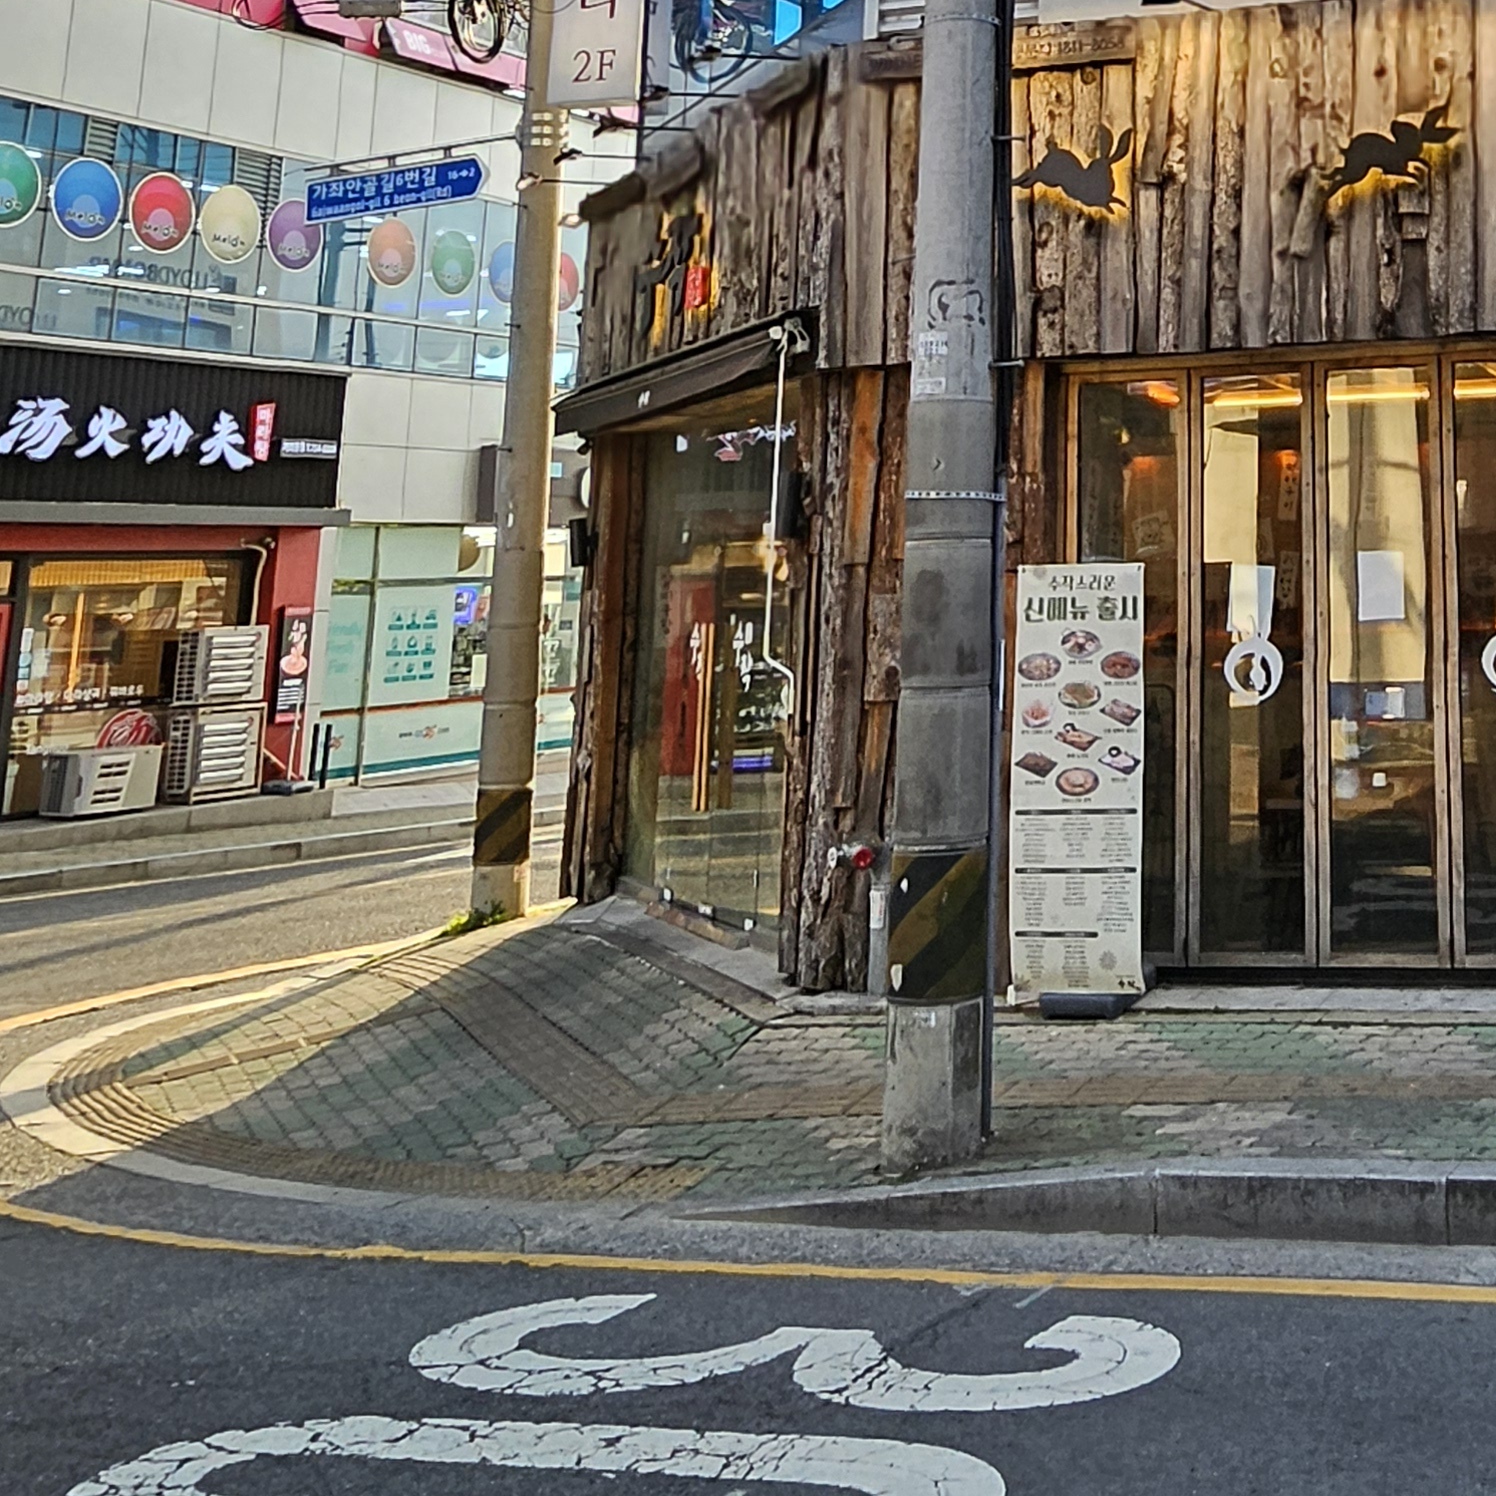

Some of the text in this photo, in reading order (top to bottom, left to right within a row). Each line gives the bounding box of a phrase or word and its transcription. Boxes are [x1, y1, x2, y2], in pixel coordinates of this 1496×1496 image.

[403, 28, 432, 55] BIG
[572, 49, 617, 83] 2F
[311, 166, 437, 200] 가좌안골길6번길
[1050, 574, 1117, 592] 수작스러운
[1023, 595, 1139, 623] 신메뉴 출시
